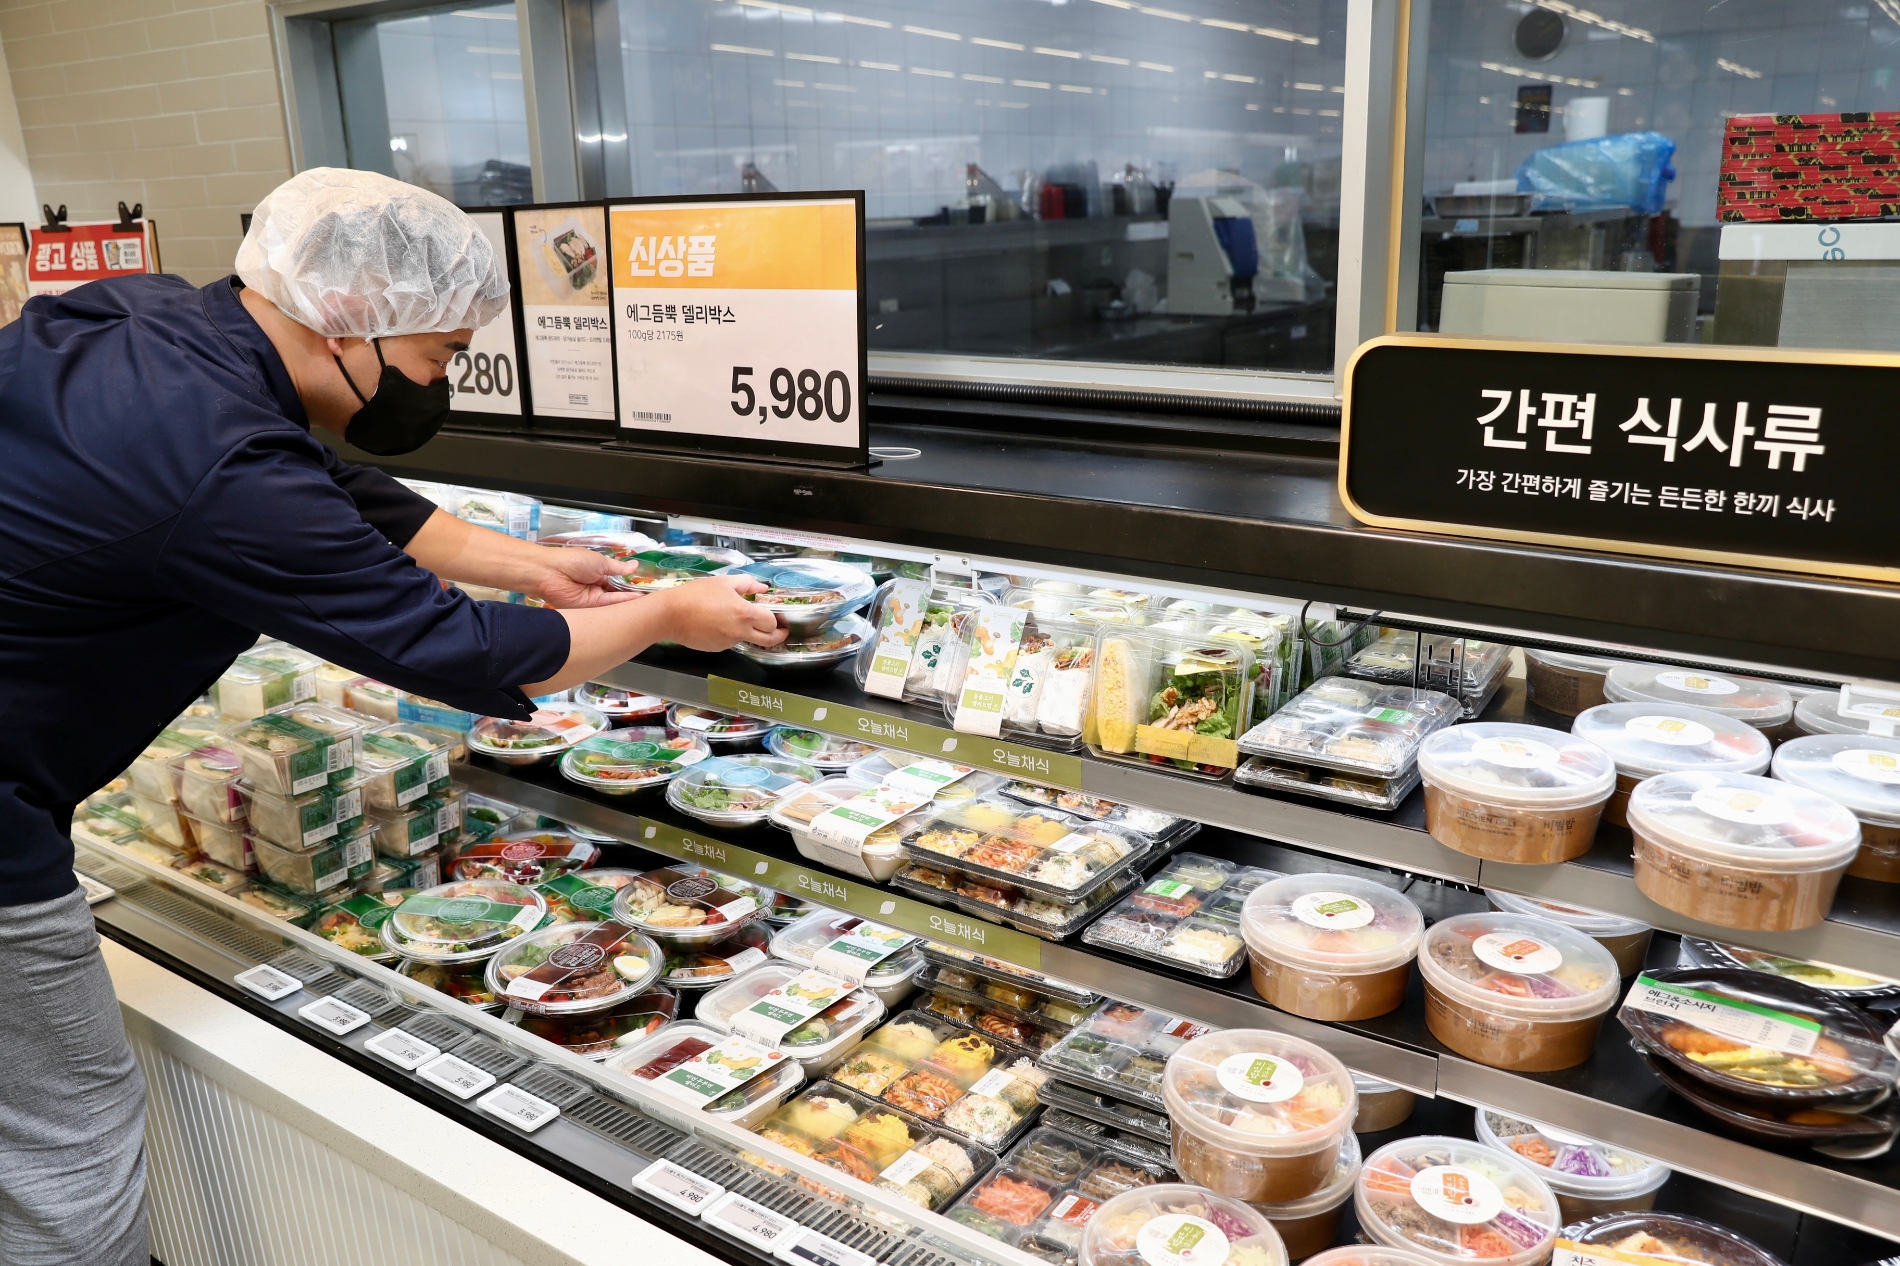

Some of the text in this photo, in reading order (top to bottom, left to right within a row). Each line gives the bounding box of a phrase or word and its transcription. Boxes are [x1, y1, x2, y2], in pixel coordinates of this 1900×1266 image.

[36, 242, 67, 272] 광고
[70, 240, 99, 272] 상품
[628, 235, 716, 277] 신상품
[538, 316, 608, 330] 에그듬뿍 델리박스
[626, 303, 736, 325] 에그듬뿍 델리박스
[628, 329, 684, 342] 100g당 2175원
[448, 351, 514, 398] ,280
[730, 366, 851, 424] 5,980
[1476, 388, 1826, 472] 간편 식사류
[1456, 468, 1836, 522] 가장 간편하게 즐기는 든든한 한끼 식사
[738, 690, 784, 712] 오늘채식
[858, 718, 908, 741] 오늘채식
[992, 748, 1050, 775] 오늘채식
[1457, 808, 1492, 824] KITCHEN
[1544, 817, 1576, 831] 비빔밥
[682, 838, 726, 863] 오늘채식
[1670, 862, 1690, 876] DELI
[798, 873, 848, 902] 오늘채식
[929, 914, 986, 945] 오늘채식
[1648, 989, 1716, 1012] 에그&소시지
[1572, 1256, 1596, 1266] 치즈
